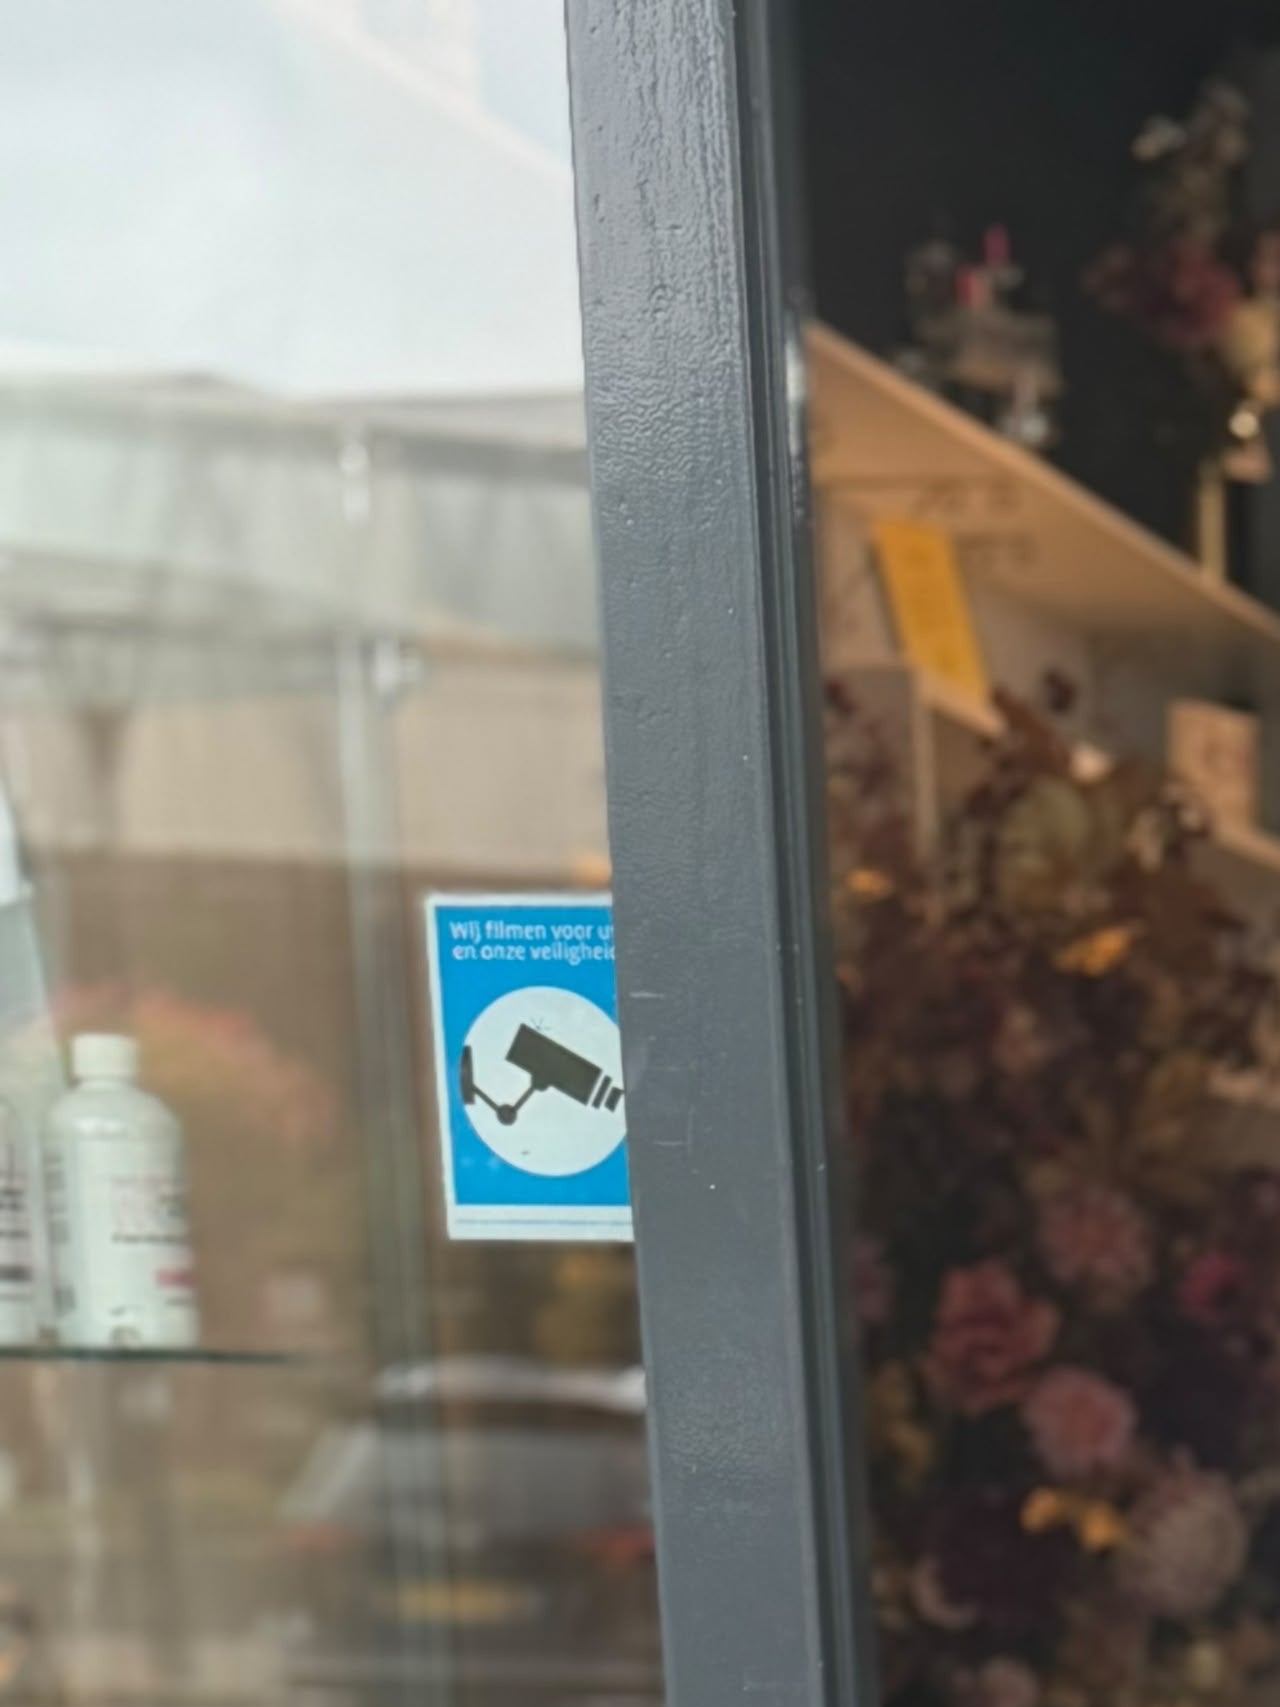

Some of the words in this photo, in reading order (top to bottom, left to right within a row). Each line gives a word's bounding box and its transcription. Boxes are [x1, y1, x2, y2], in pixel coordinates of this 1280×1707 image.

[450, 920, 481, 944] Wij
[485, 920, 547, 940] filmen
[551, 924, 593, 940] voor
[597, 924, 614, 940] u
[452, 945, 476, 960] en
[480, 945, 525, 960] onze
